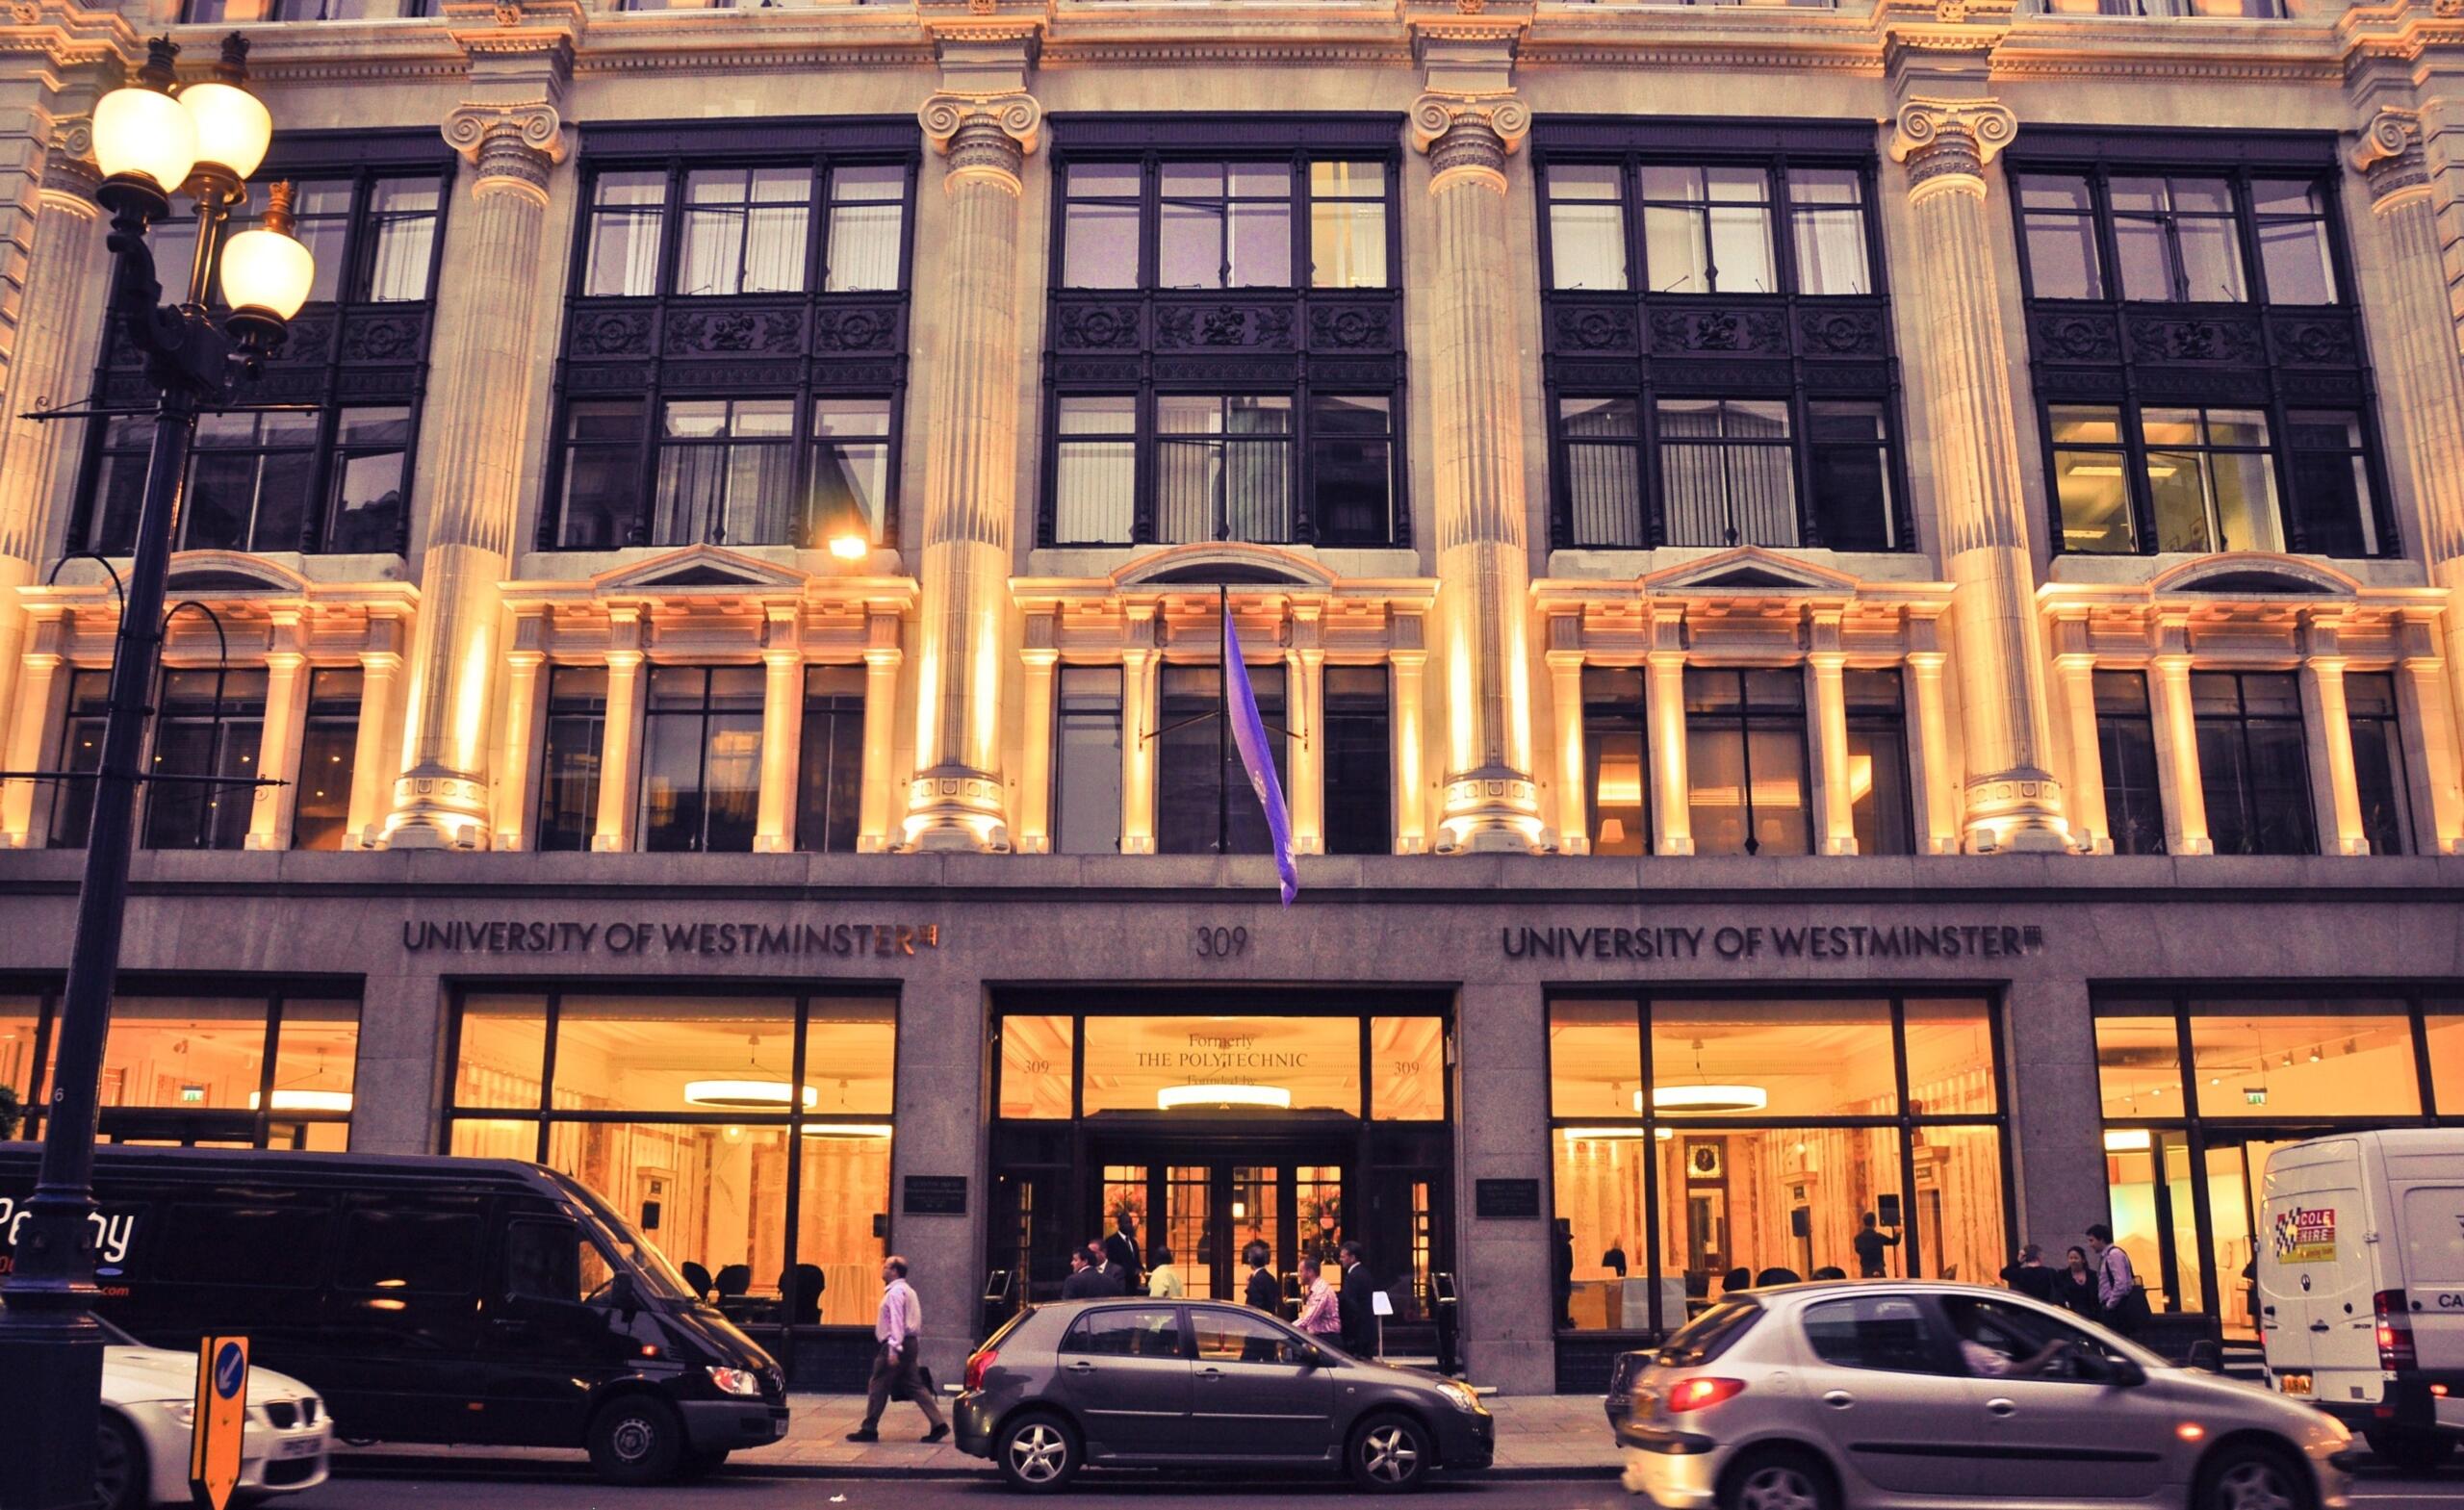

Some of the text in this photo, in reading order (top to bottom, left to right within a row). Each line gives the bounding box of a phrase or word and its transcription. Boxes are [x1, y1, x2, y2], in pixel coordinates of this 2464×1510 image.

[402, 921, 914, 955] UNIVERSITY OF WESTMINSTER
[1196, 926, 1247, 957] 309
[1502, 926, 2022, 958] UNIVERSITY OF WESTMINSTER
[1188, 1034, 1254, 1050] Formerly
[1023, 1060, 1049, 1074] 309
[1136, 1053, 1308, 1067] THE POLYTECHNIC
[1394, 1061, 1420, 1076] 309
[55, 1088, 64, 1102] 6
[2300, 1211, 2331, 1226] COLE
[2300, 1228, 2328, 1242] HIRE
